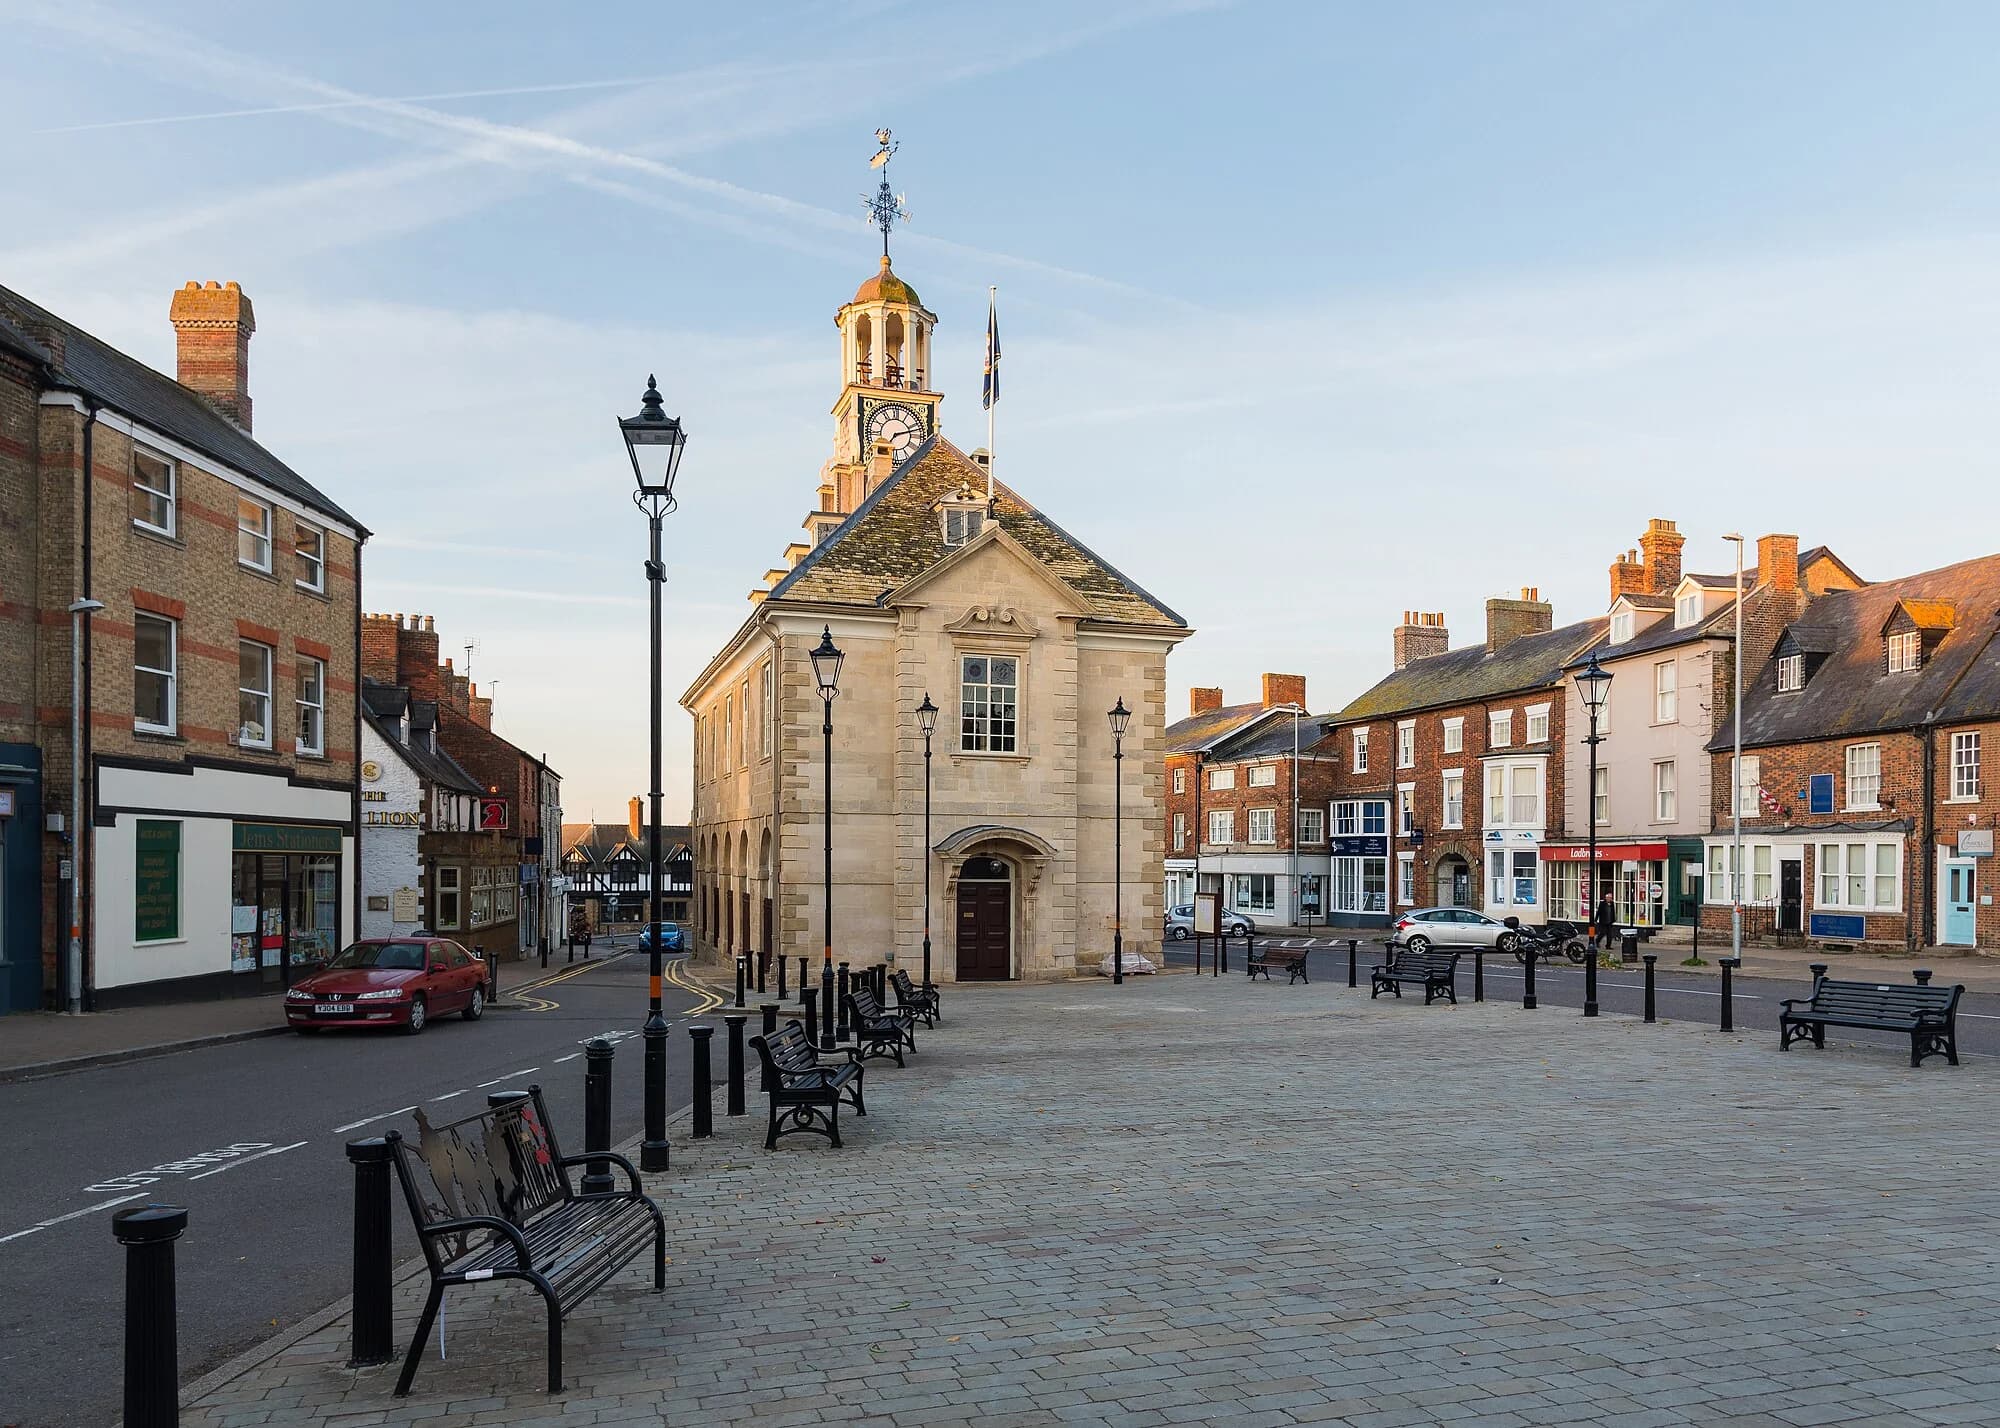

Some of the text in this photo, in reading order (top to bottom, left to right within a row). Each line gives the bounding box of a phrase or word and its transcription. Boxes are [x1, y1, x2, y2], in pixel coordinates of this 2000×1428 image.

[364, 791, 387, 802] HE
[368, 811, 419, 825] LION
[1570, 848, 1603, 858] Ladbres
[83, 1142, 273, 1192] DISABLED
